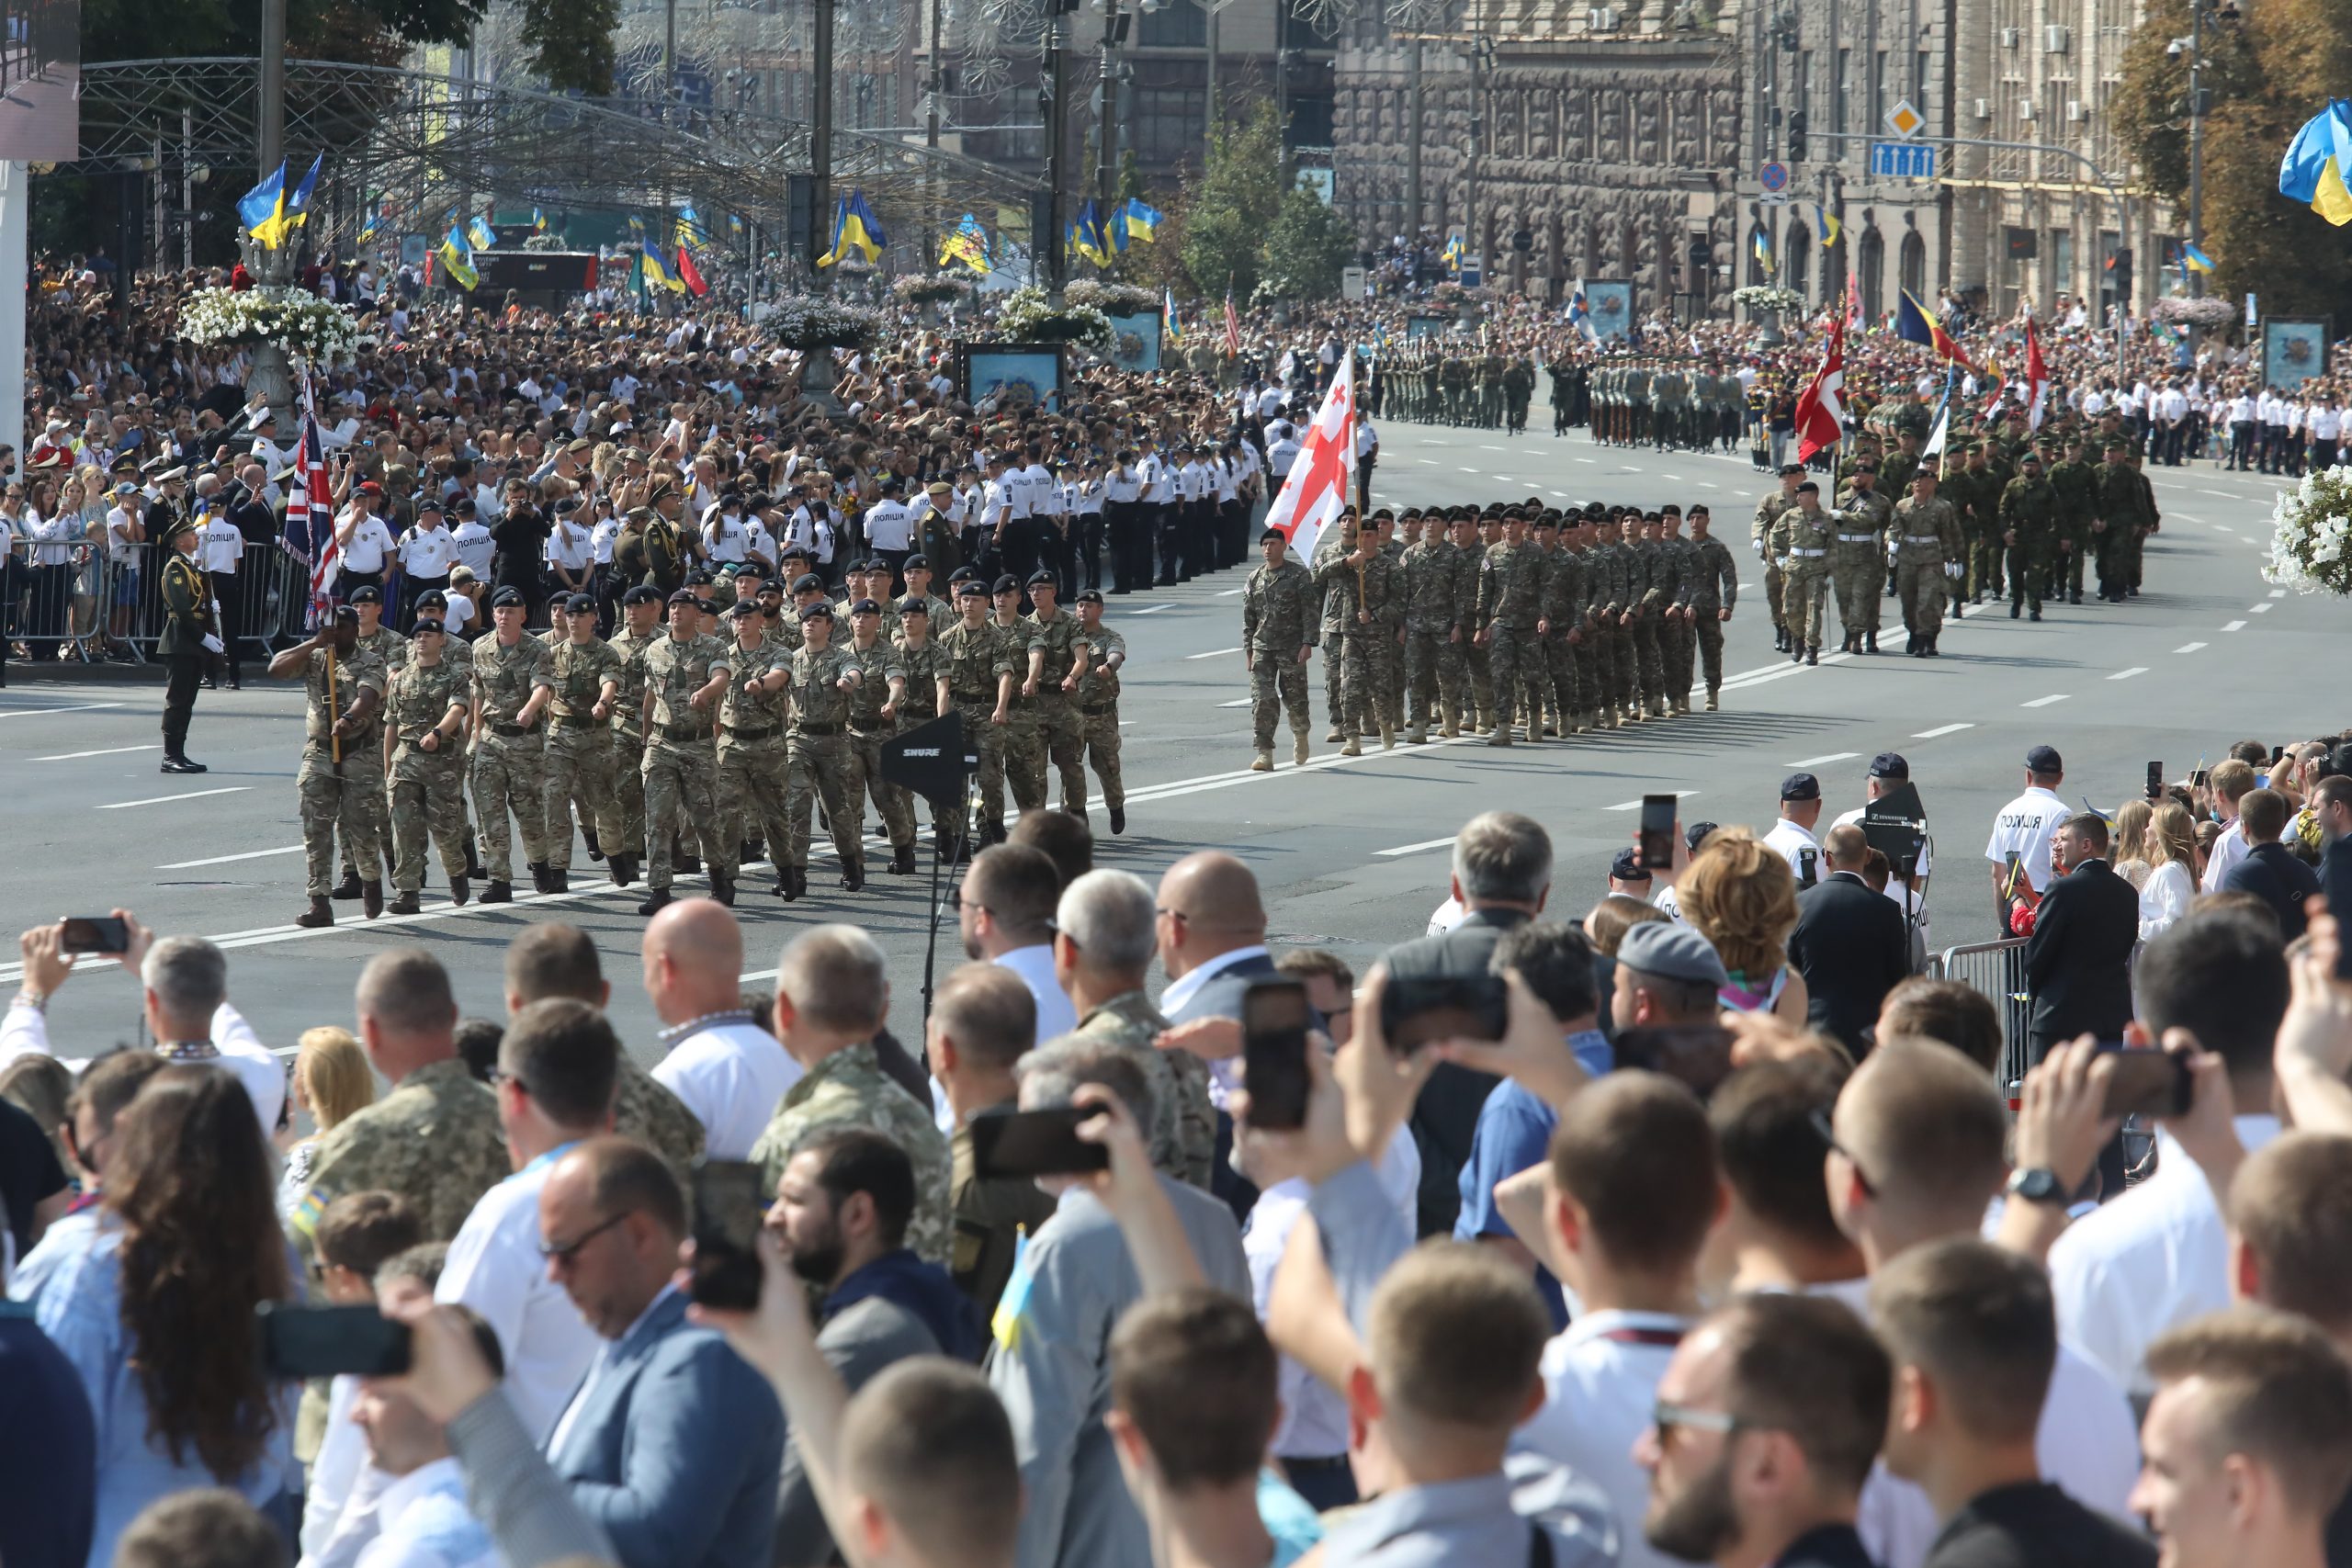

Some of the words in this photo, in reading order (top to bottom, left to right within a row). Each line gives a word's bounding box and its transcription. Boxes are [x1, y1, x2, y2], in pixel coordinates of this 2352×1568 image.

[875, 513, 905, 522] ПОЛІЦІЯ
[458, 535, 491, 548] ПОЛІЦІЯ
[903, 748, 942, 757] SHURE
[2001, 815, 2041, 829] ПОЛІЦІЯ
